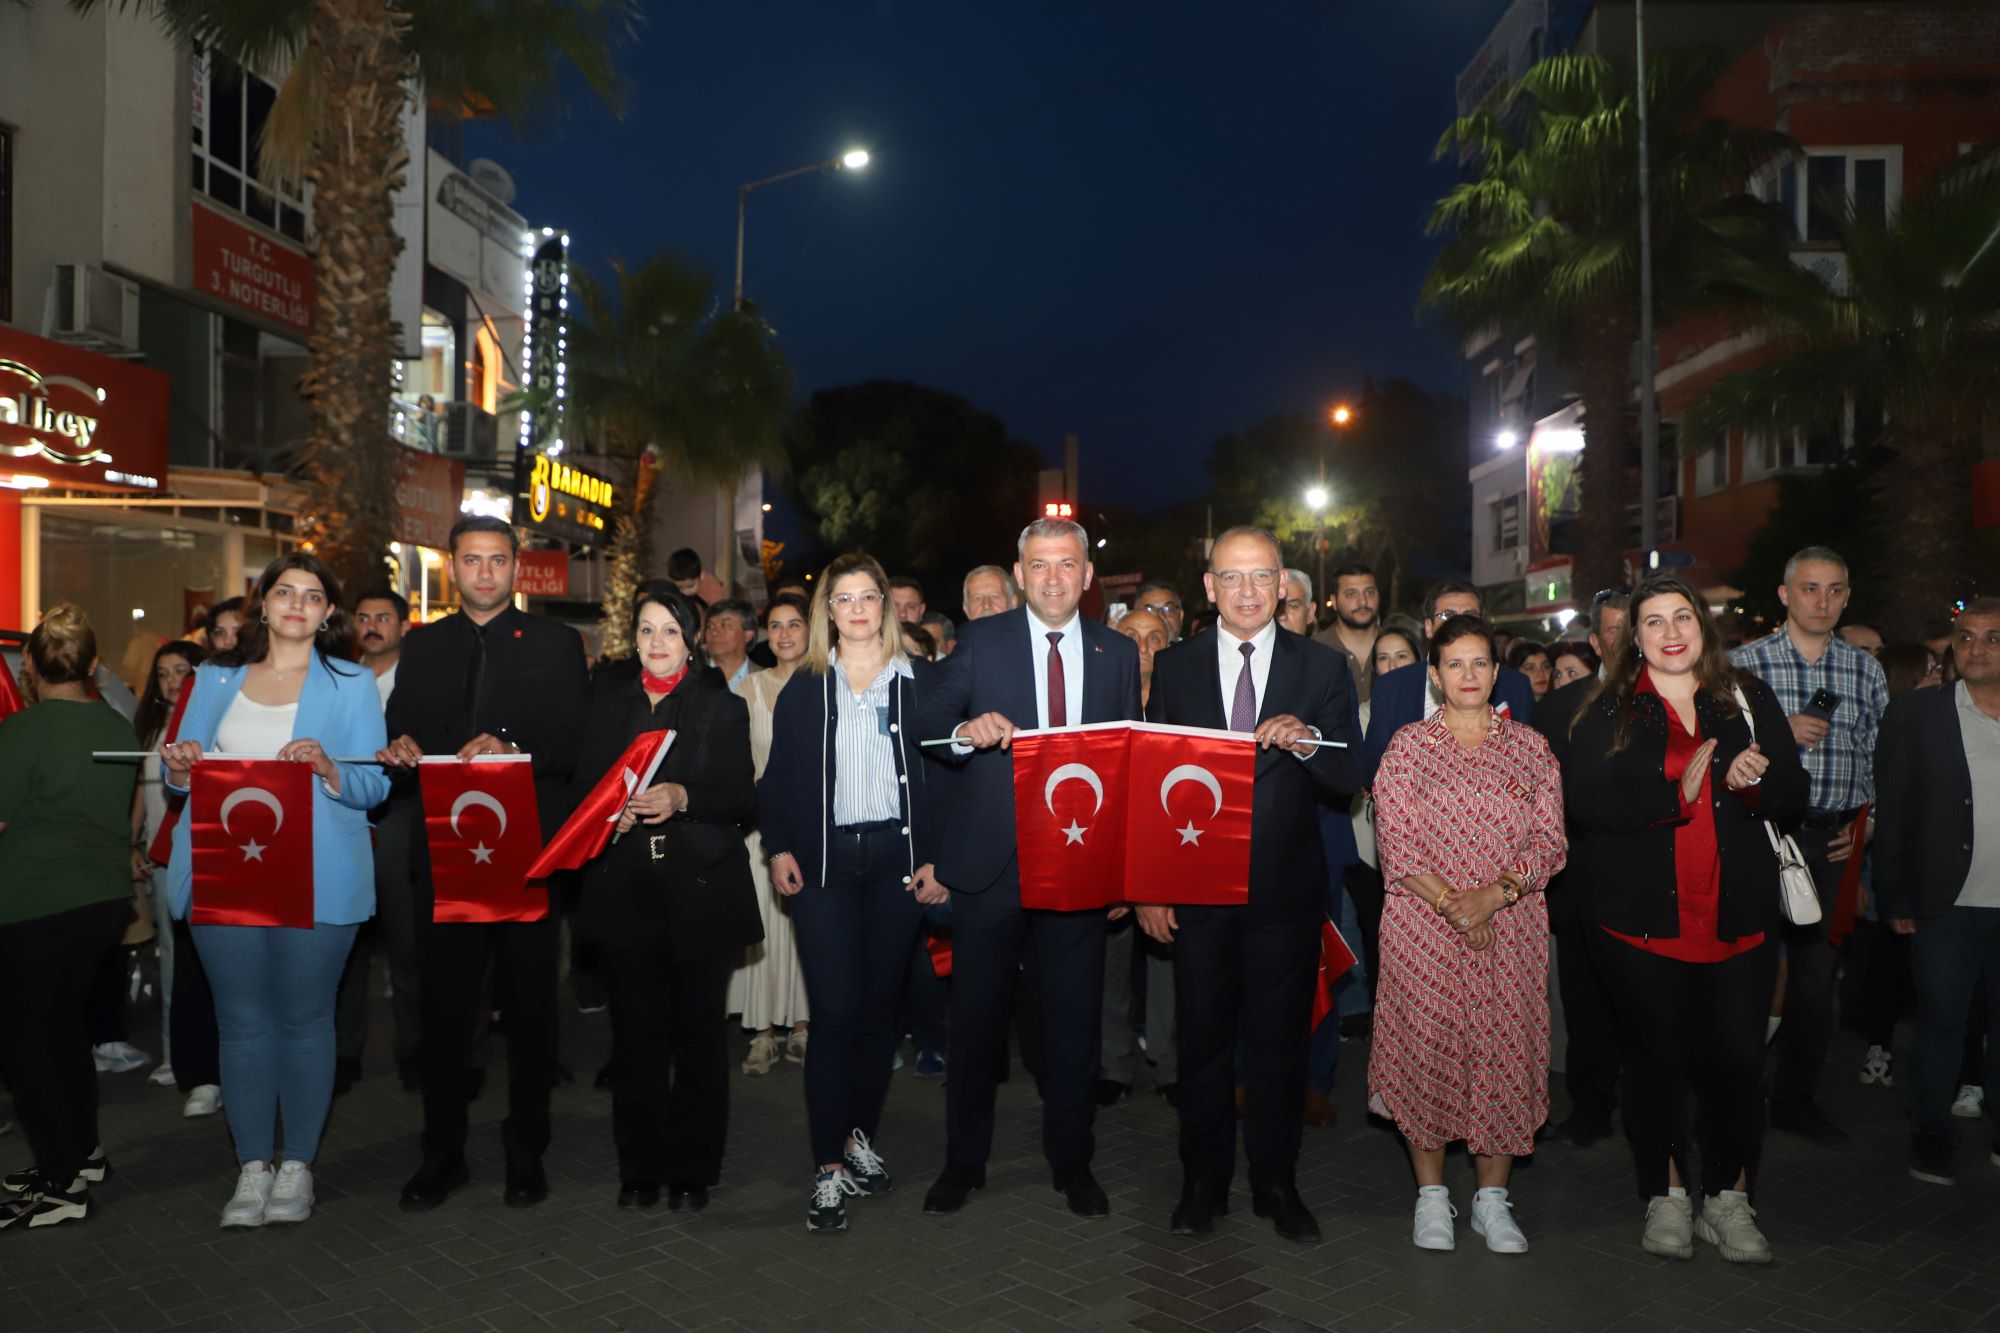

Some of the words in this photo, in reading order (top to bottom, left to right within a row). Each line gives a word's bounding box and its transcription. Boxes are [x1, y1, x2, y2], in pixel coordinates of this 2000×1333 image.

[220, 247, 302, 300] TURGUTLU
[247, 235, 276, 264] T.C.
[210, 270, 226, 294] 3.
[229, 277, 310, 328] NOTERLİĞİ
[550, 461, 613, 509] BAHADIR
[517, 565, 556, 579] UTLU
